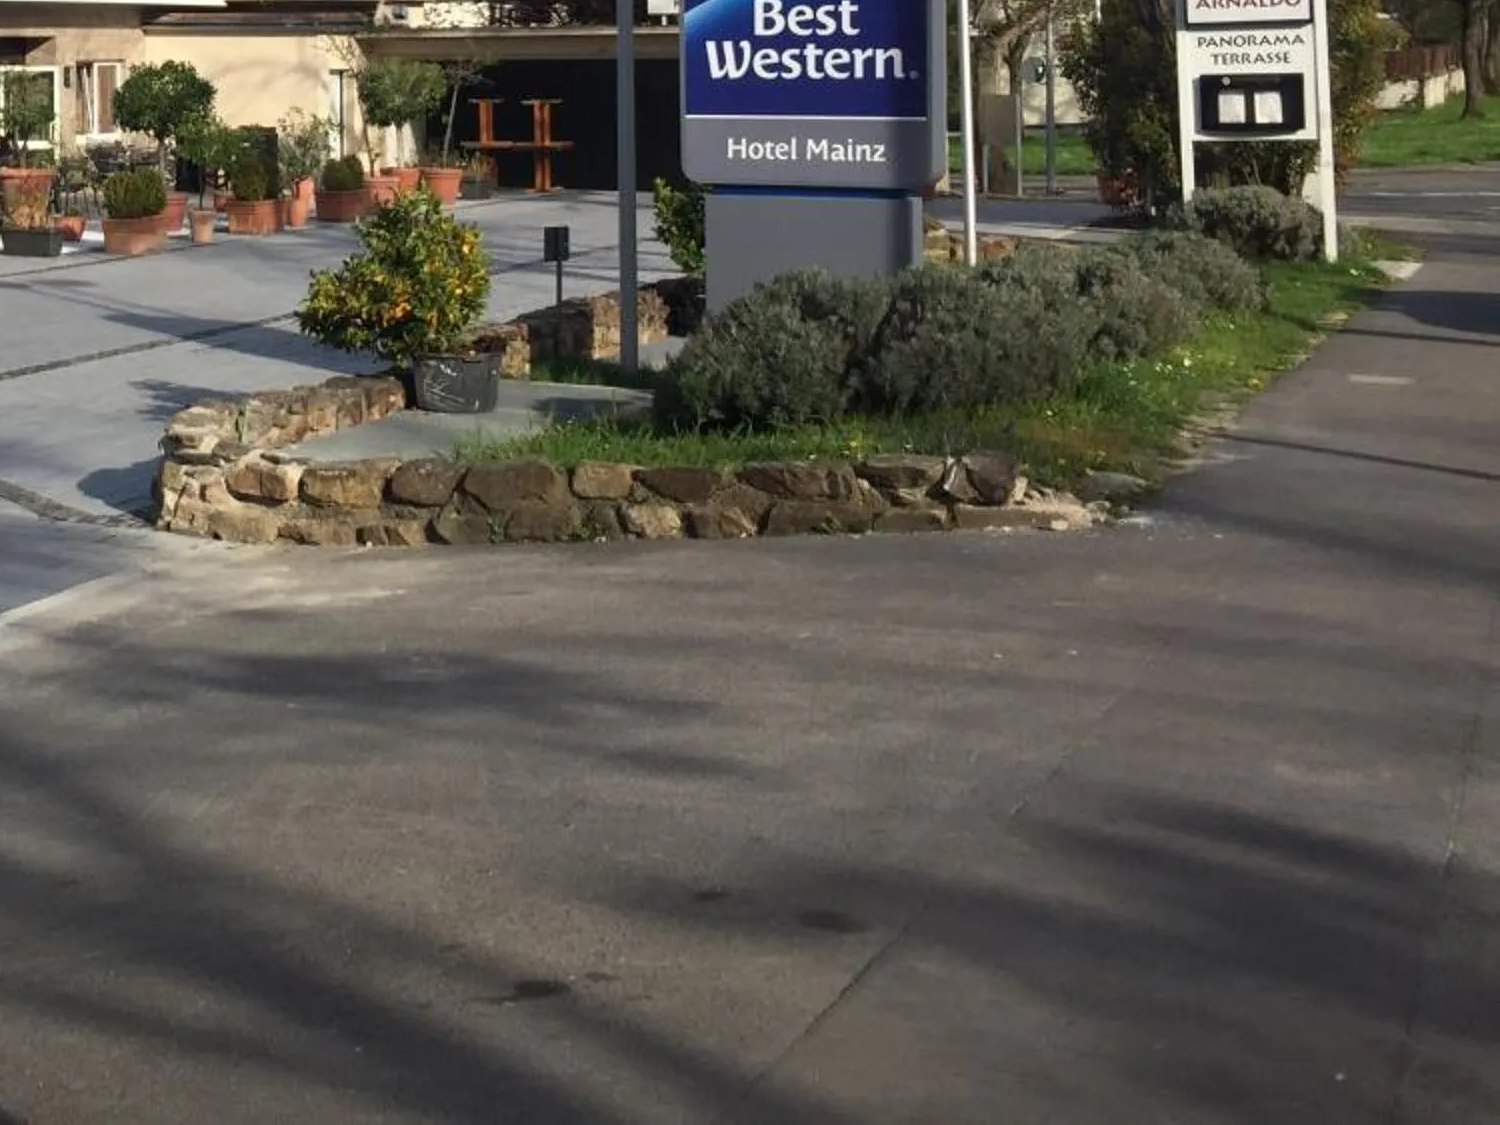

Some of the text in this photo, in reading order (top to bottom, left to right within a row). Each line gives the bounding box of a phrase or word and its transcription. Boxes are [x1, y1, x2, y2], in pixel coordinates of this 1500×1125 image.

[1197, 34, 1305, 48] PANORAMA
[1211, 52, 1292, 66] TERRASSE
[726, 137, 886, 162] Hotel Mainz
